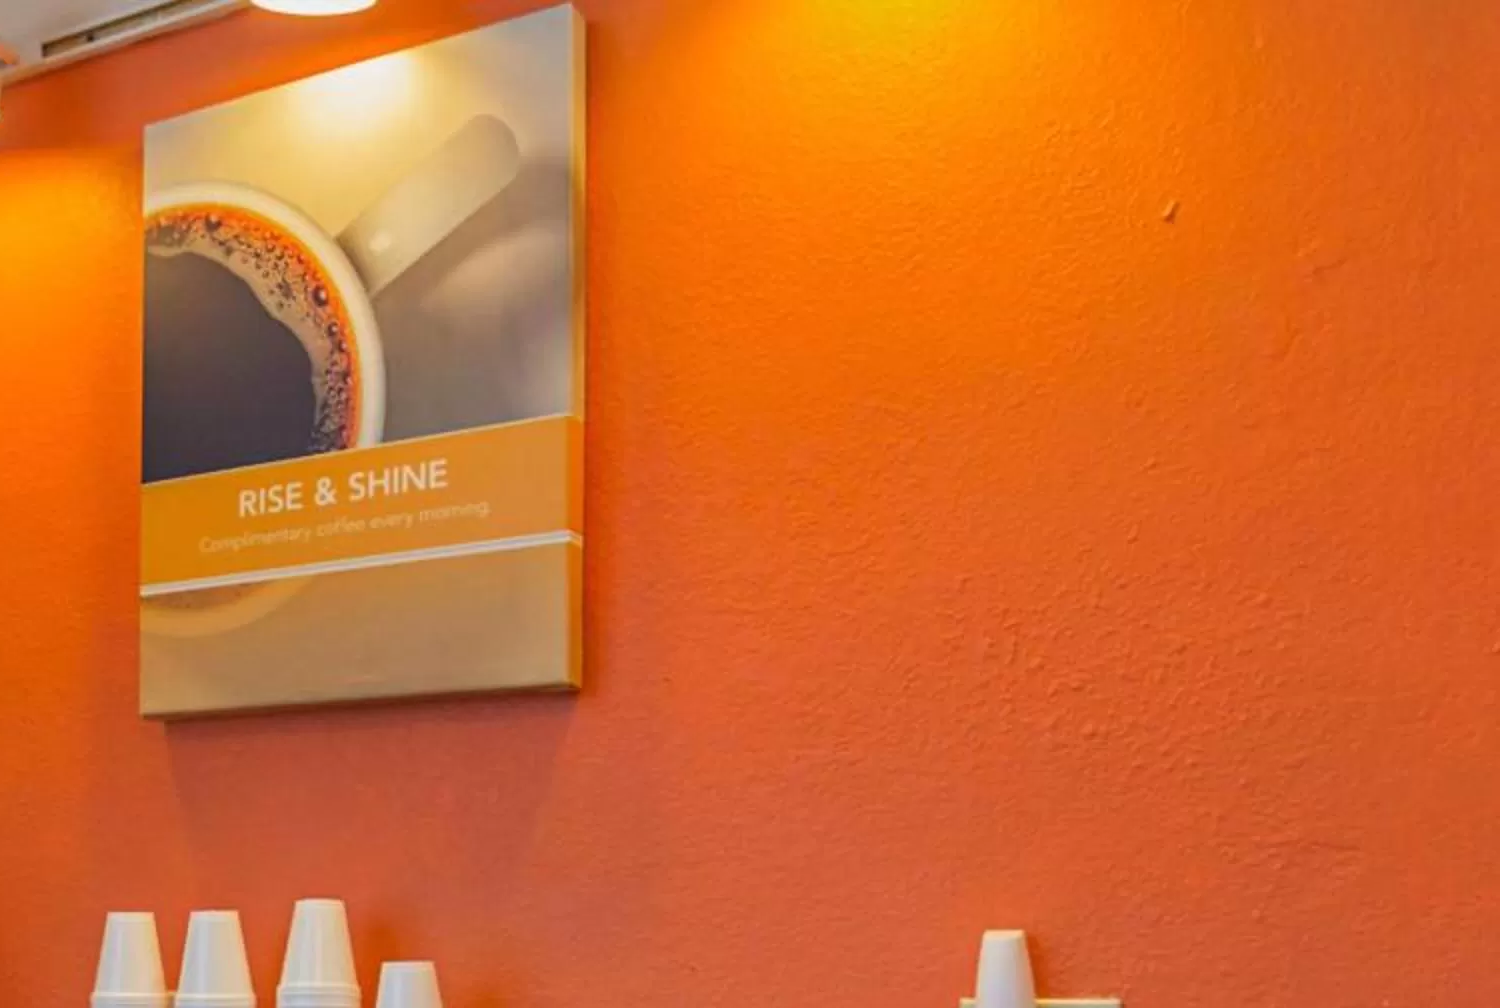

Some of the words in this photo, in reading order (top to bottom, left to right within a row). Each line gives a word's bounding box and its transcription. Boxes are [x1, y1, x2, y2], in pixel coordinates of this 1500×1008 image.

[238, 481, 304, 518] RISE
[314, 475, 337, 506] &
[348, 457, 449, 502] SHINE
[199, 527, 311, 553] Complimentary
[316, 515, 366, 537] coffee
[369, 512, 413, 530] every
